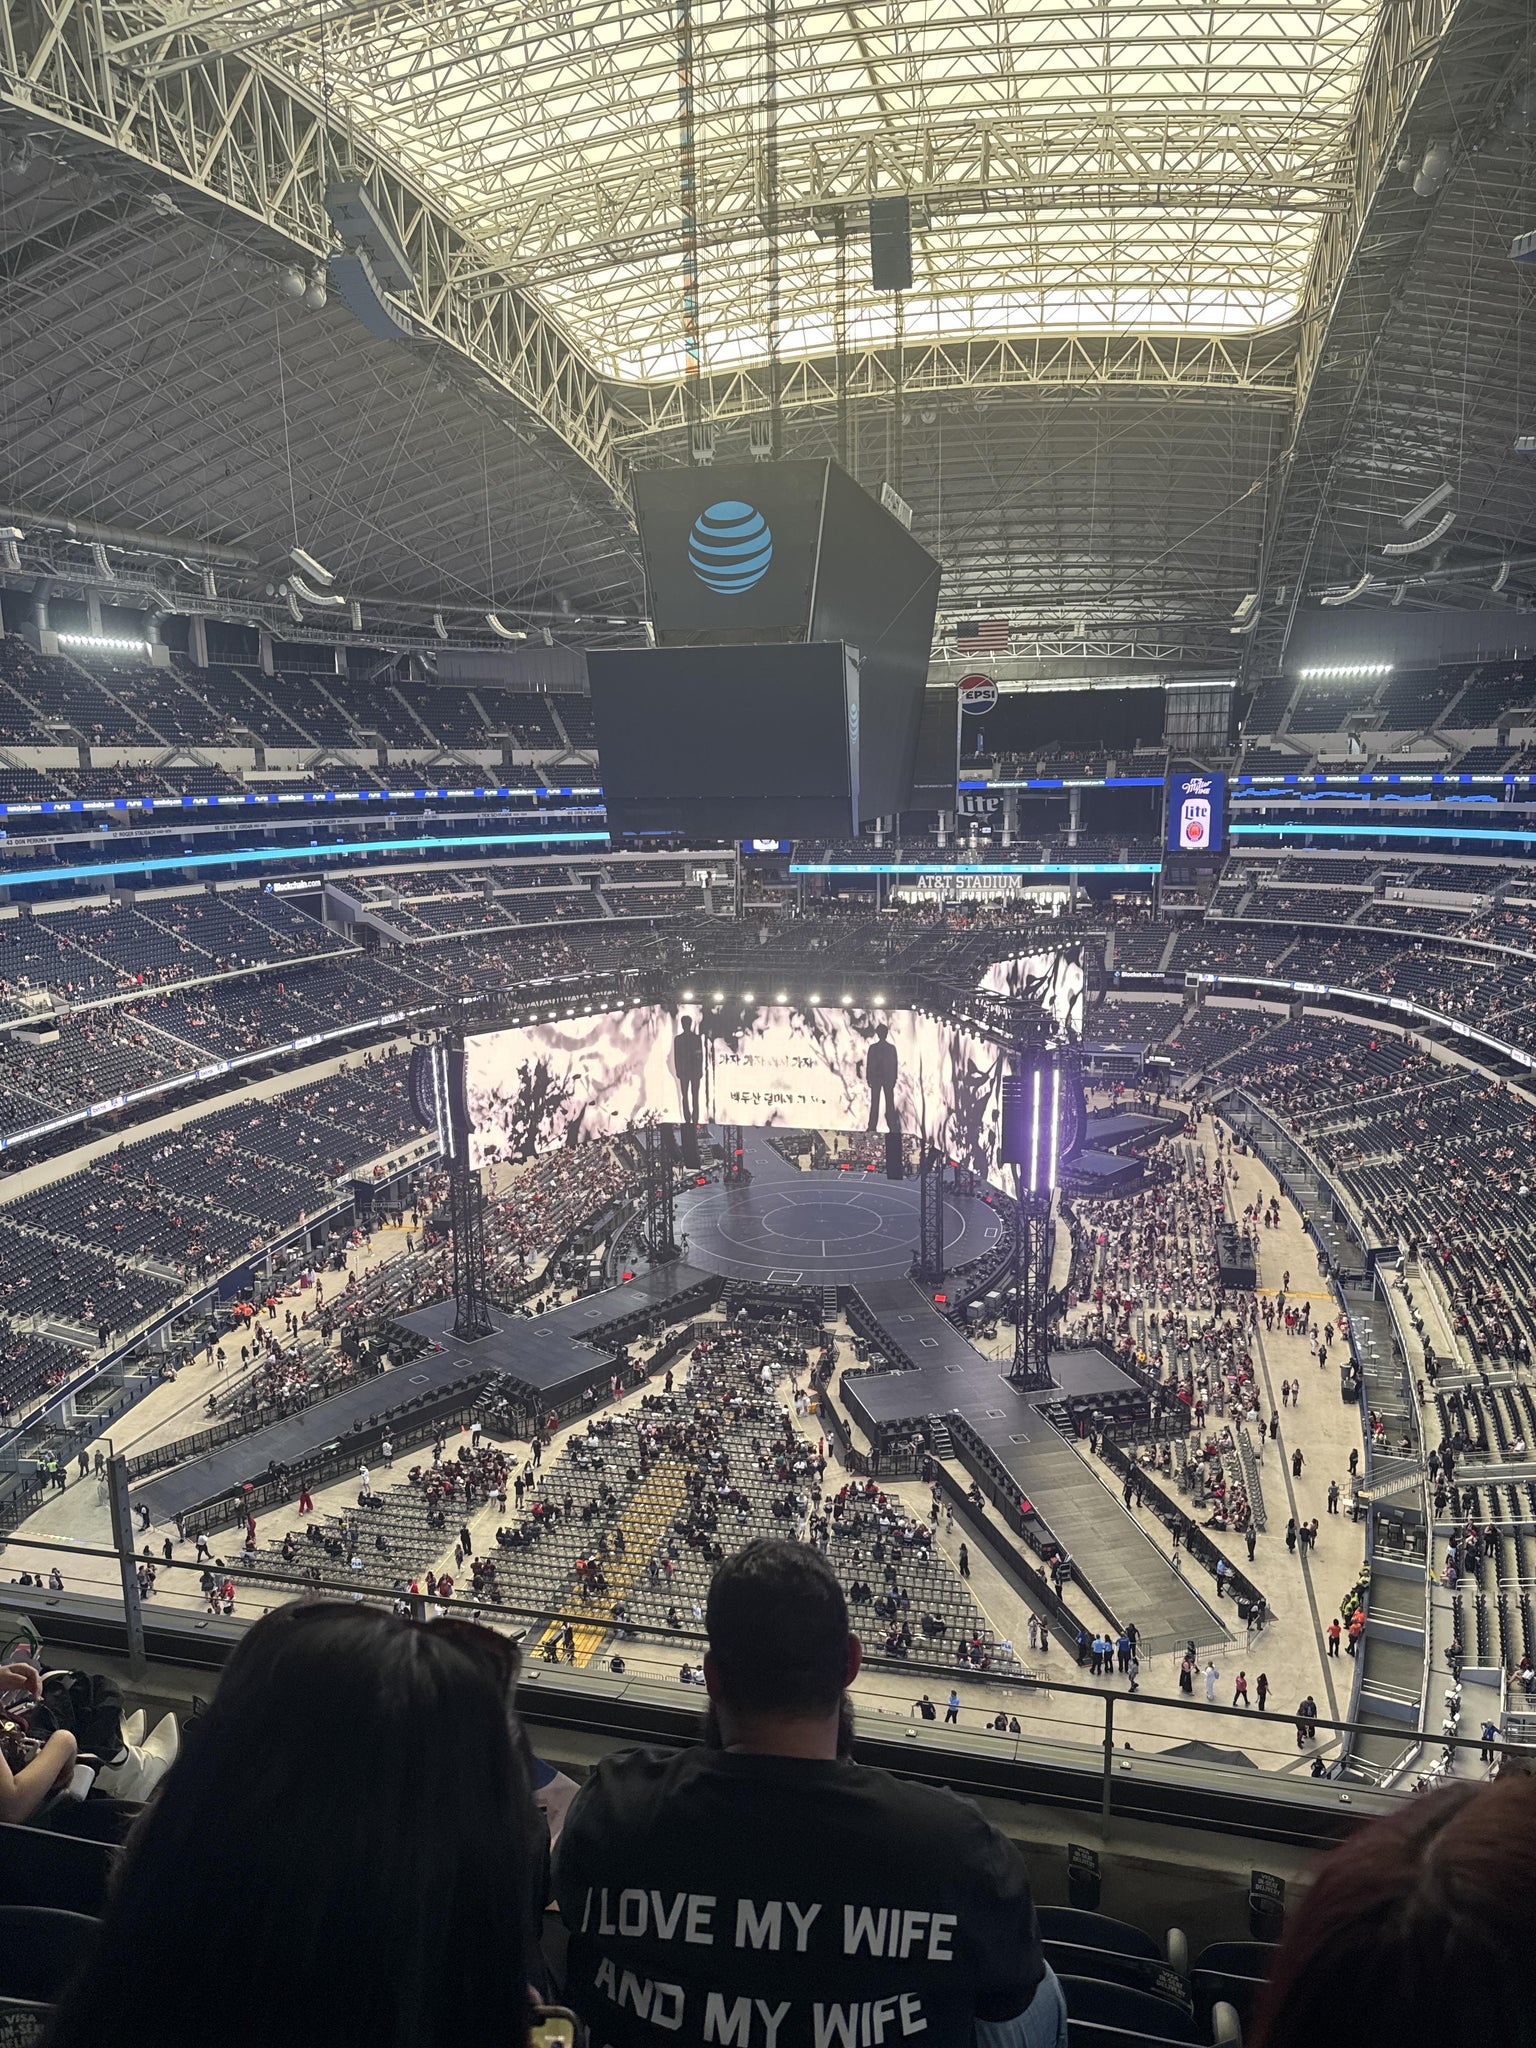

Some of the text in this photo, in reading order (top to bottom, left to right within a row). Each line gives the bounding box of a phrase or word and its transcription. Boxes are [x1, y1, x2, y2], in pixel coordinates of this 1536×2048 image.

[957, 796, 999, 816] Lite
[1185, 806, 1208, 820] Lite
[273, 880, 321, 892] Blockchain.com
[916, 875, 1022, 889] AT&T STADIUM
[730, 1092, 761, 1105] 백두산
[581, 1887, 958, 1961] I LOVE MY WIFE
[594, 1957, 928, 2048] AND MY WIFE
